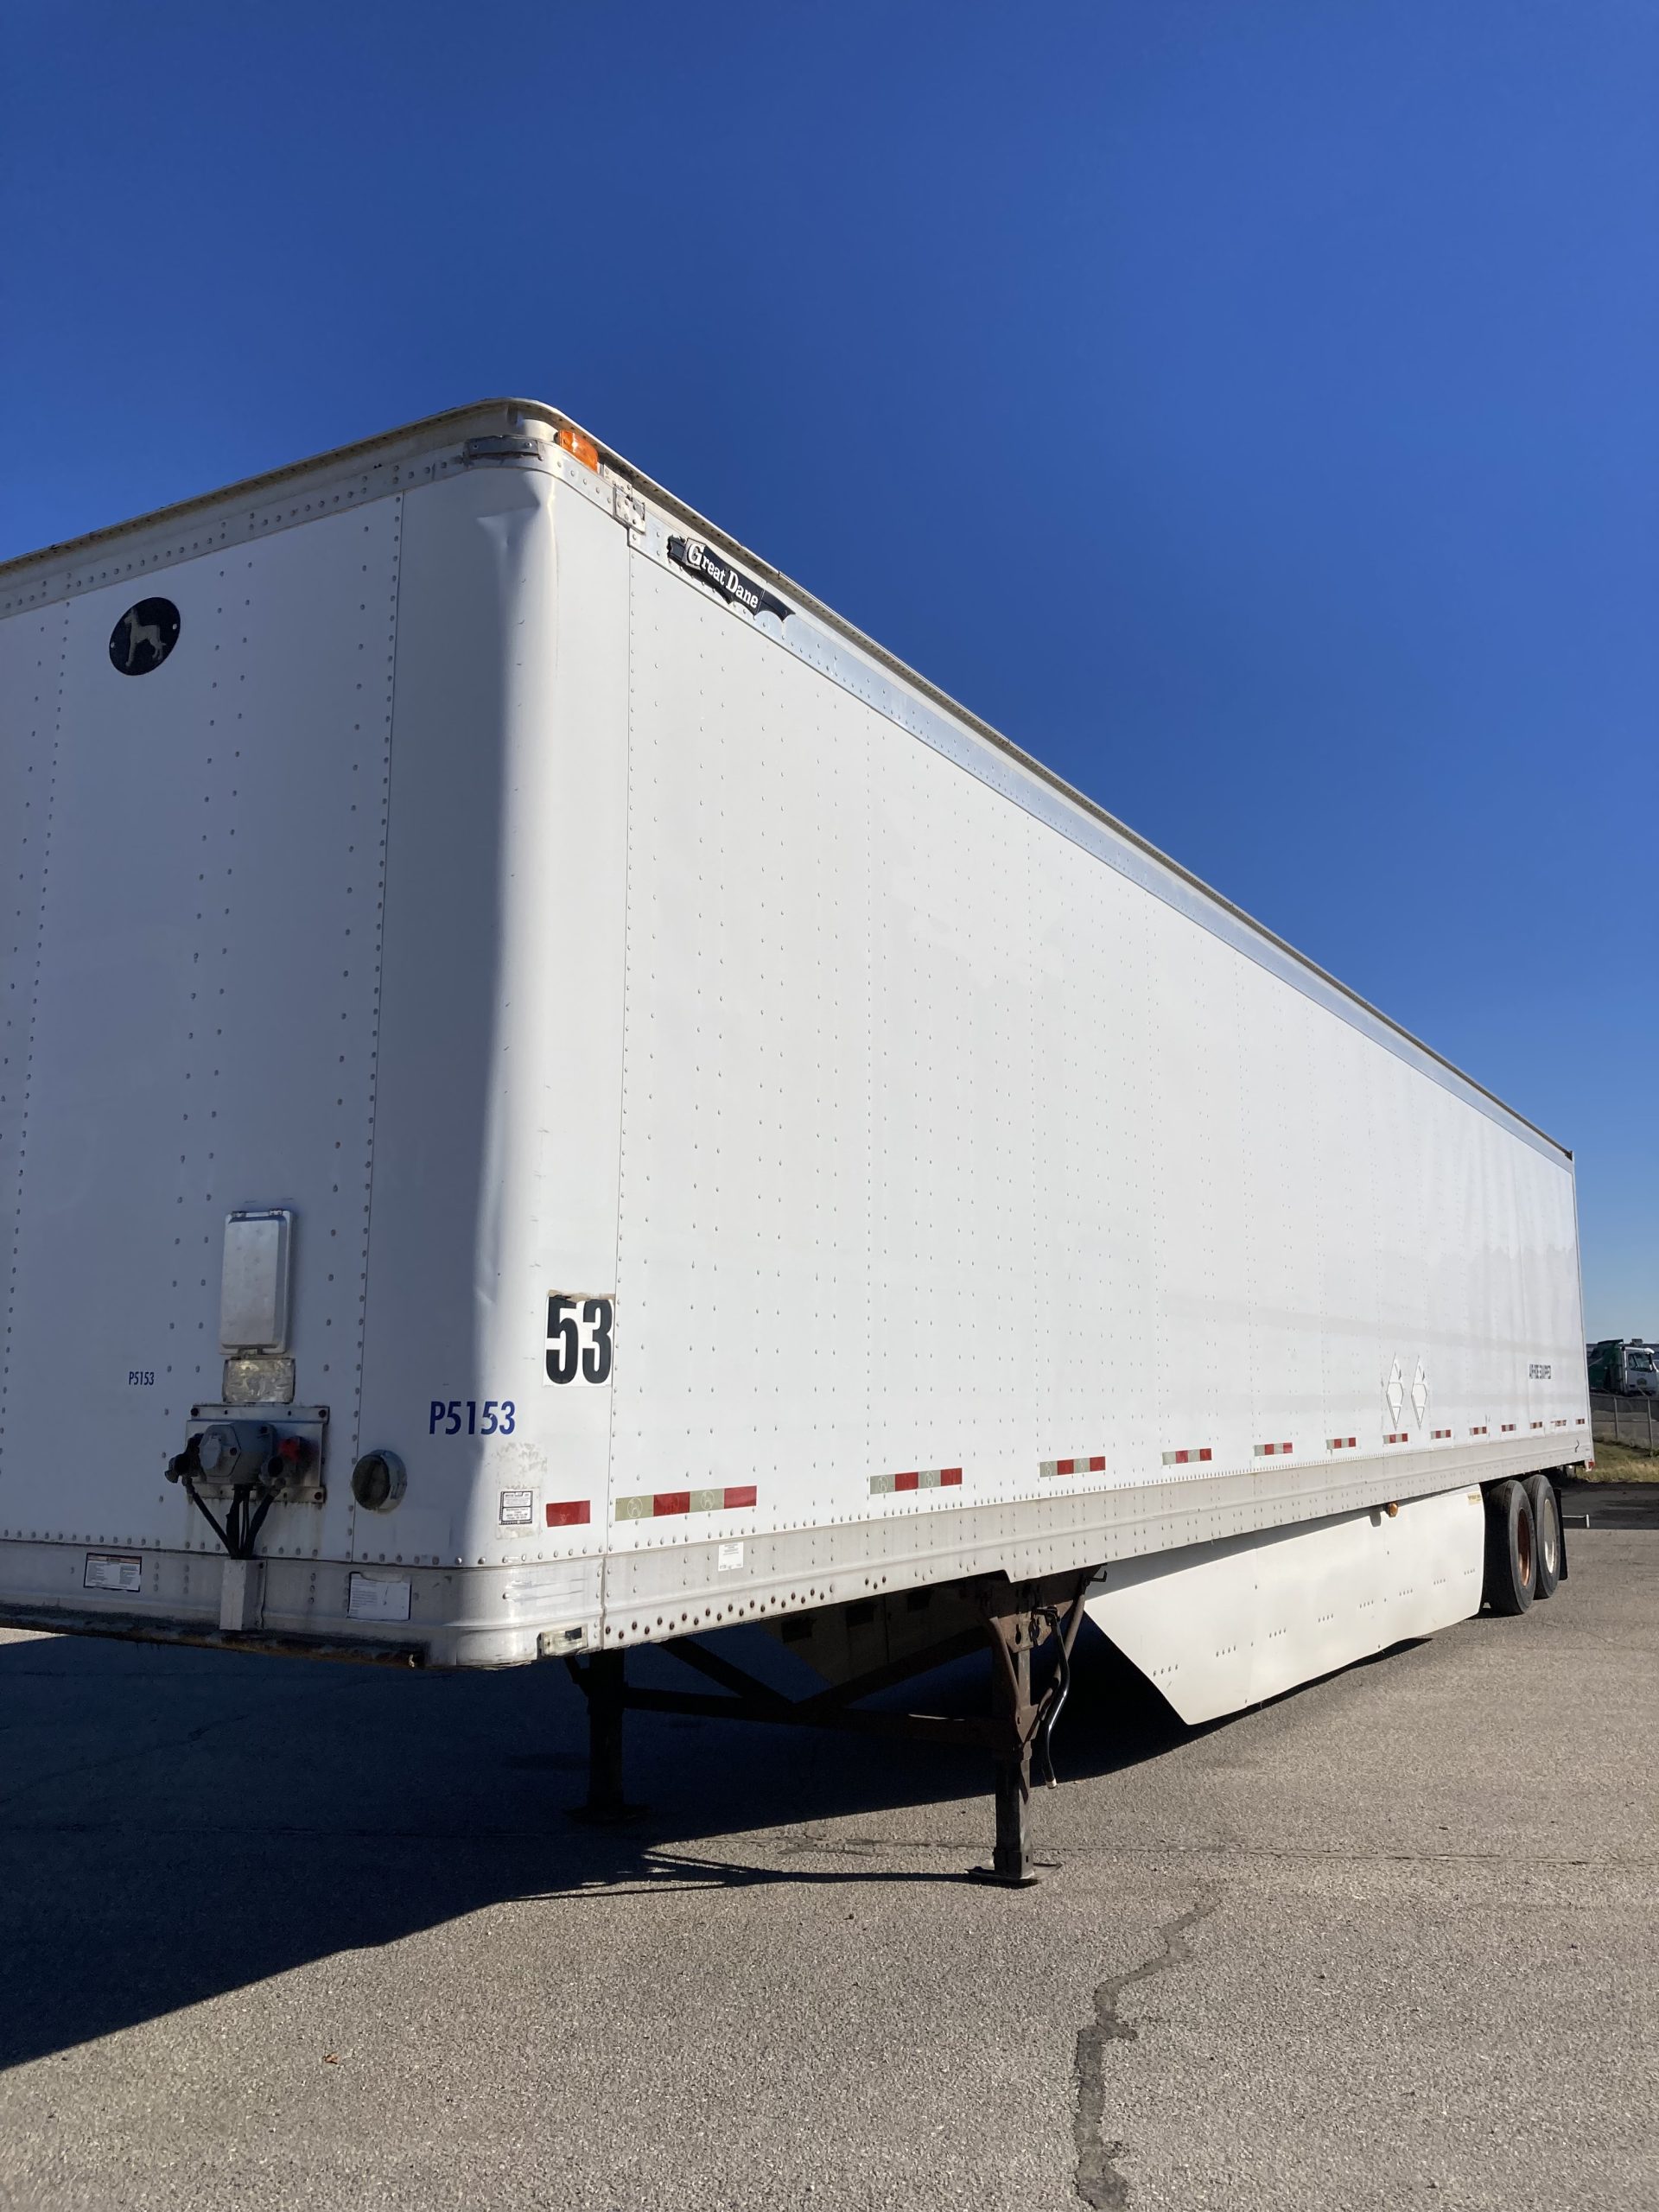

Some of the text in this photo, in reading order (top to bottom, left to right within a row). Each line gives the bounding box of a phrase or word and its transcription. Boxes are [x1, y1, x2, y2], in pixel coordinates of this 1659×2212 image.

[688, 543, 759, 609] Great Dane
[546, 1294, 613, 1384] 53
[129, 1371, 155, 1385] P5153
[429, 1401, 516, 1435] P5153
